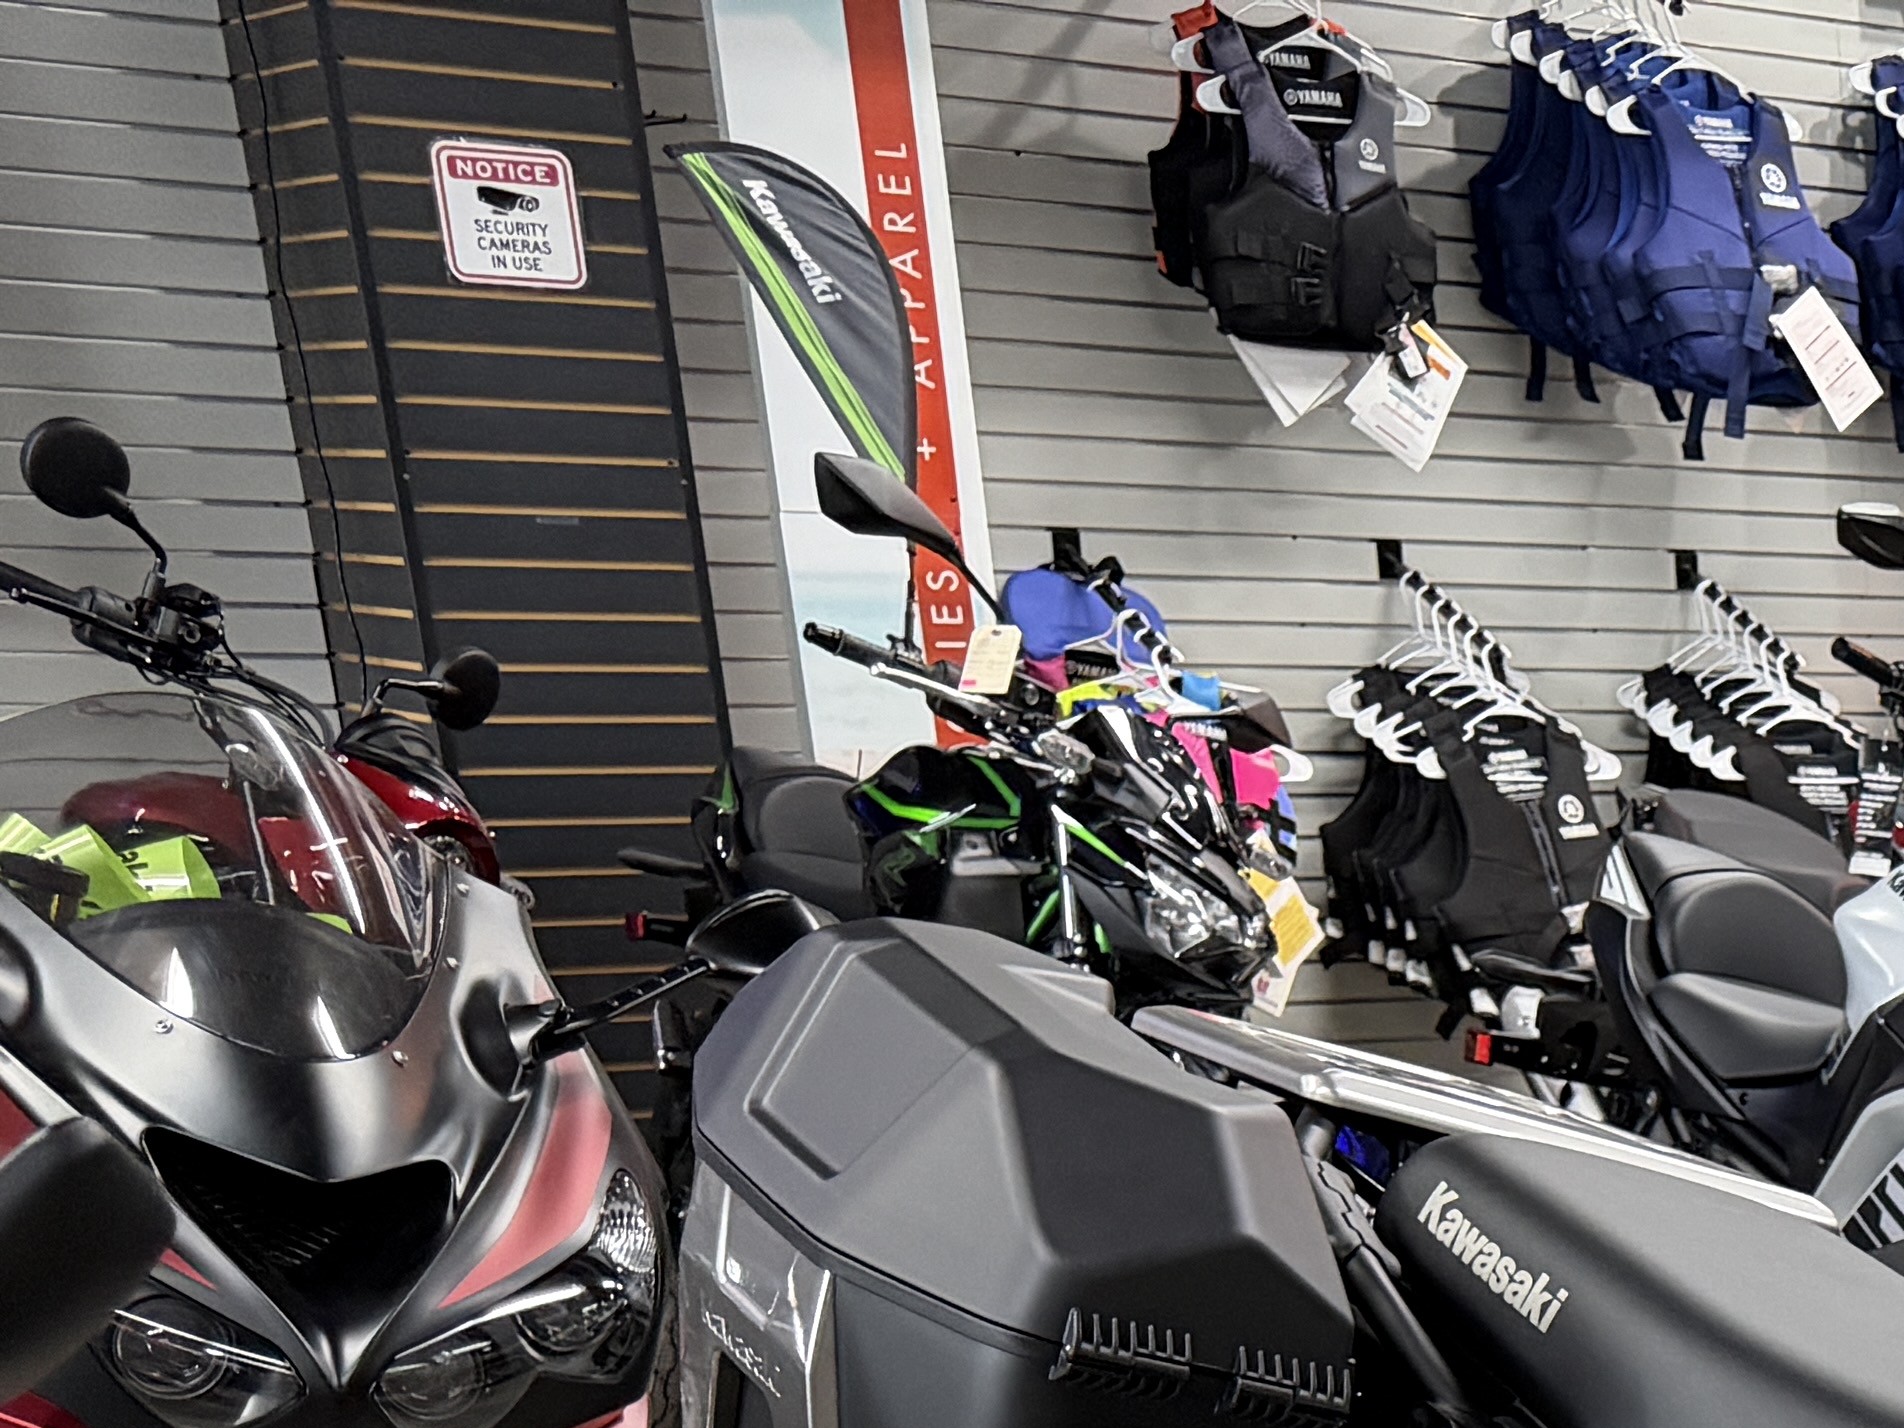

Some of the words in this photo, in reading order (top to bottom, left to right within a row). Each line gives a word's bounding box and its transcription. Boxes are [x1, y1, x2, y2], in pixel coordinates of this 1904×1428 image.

[1297, 88, 1343, 108] YAMAHA
[455, 158, 552, 184] NOTICE
[474, 218, 548, 237] SECURITY
[477, 236, 552, 255] CAMERAS
[742, 179, 843, 304] Kawasaki
[492, 254, 507, 269] IN
[512, 256, 543, 272] USE
[1416, 1181, 1571, 1334] Kawasaki
